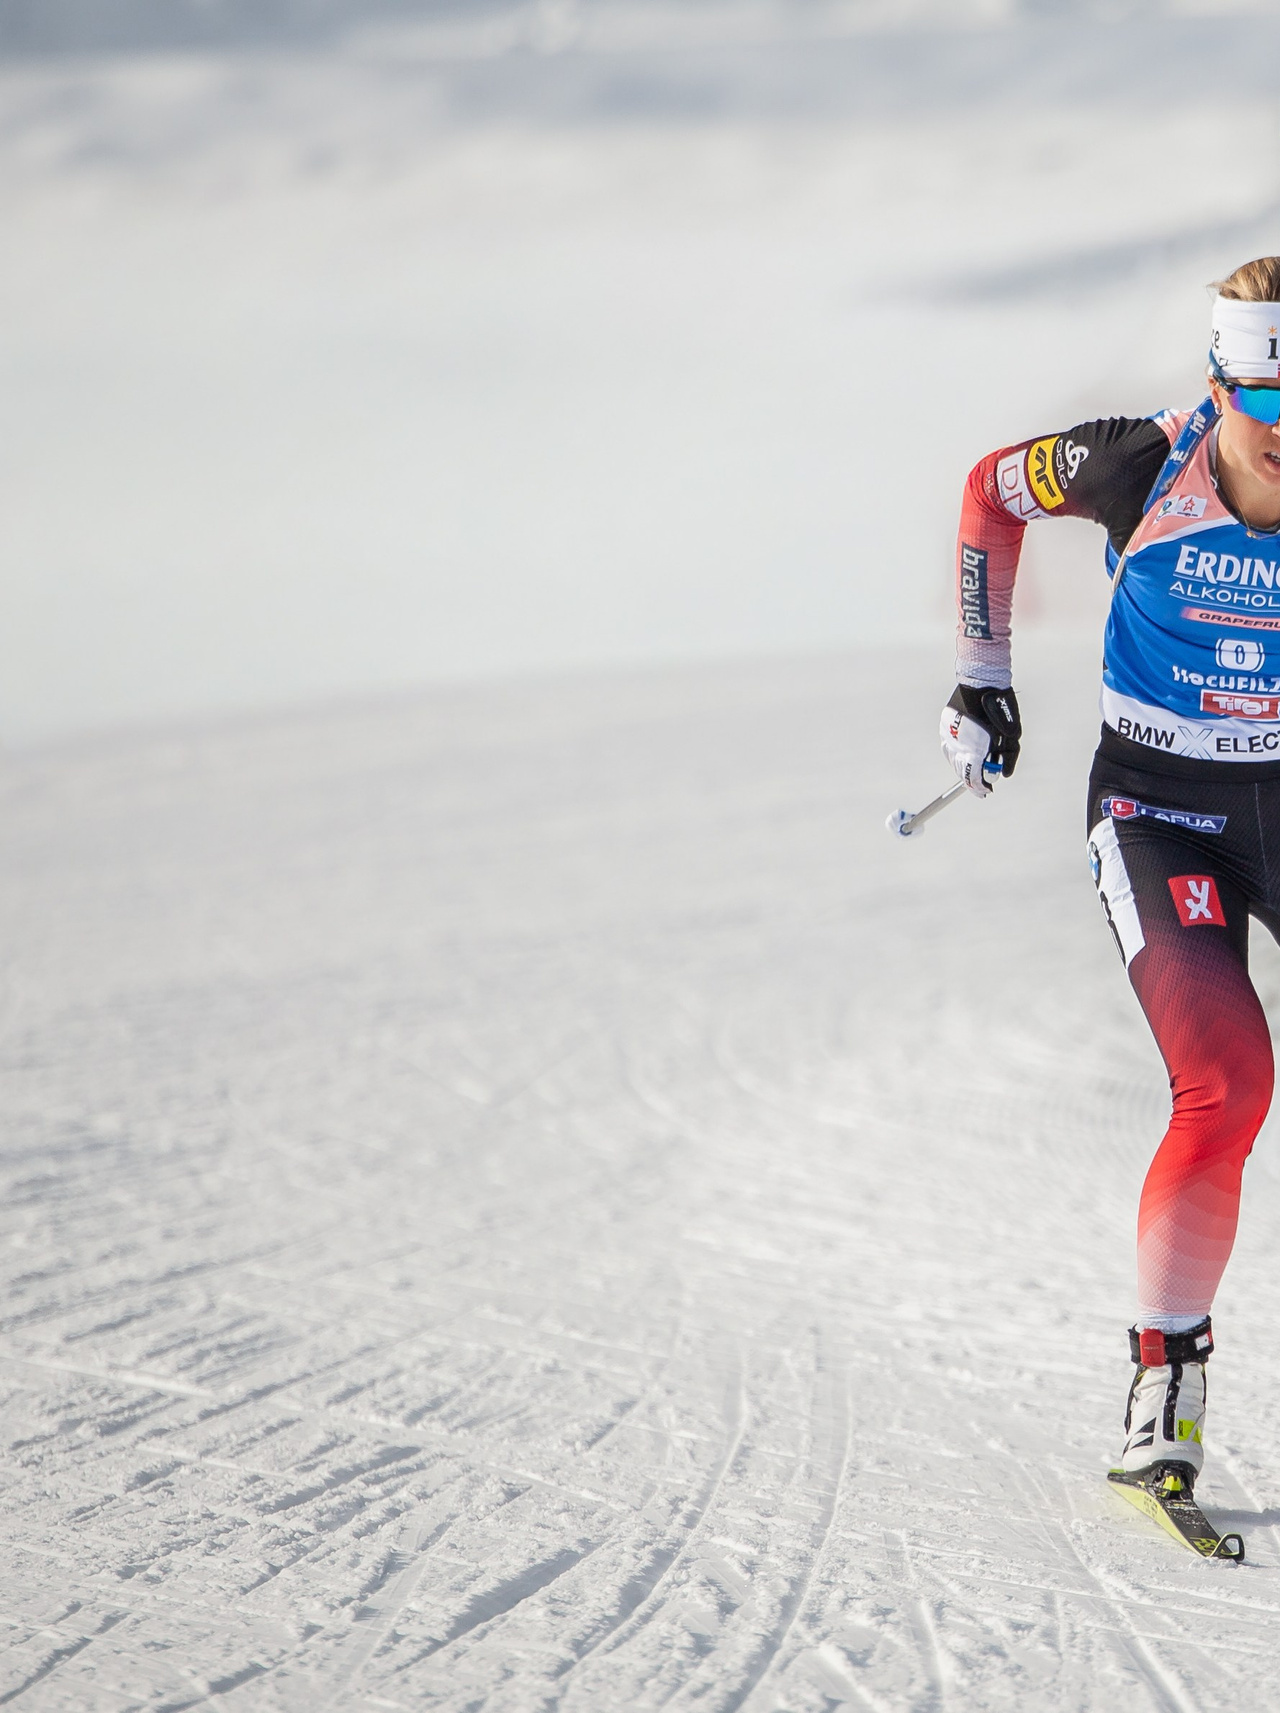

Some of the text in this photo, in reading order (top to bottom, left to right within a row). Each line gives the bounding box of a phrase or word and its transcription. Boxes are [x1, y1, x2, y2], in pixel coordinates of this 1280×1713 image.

[1002, 464, 1042, 519] DN
[963, 548, 986, 638] bravida
[1117, 717, 1176, 748] BMW
